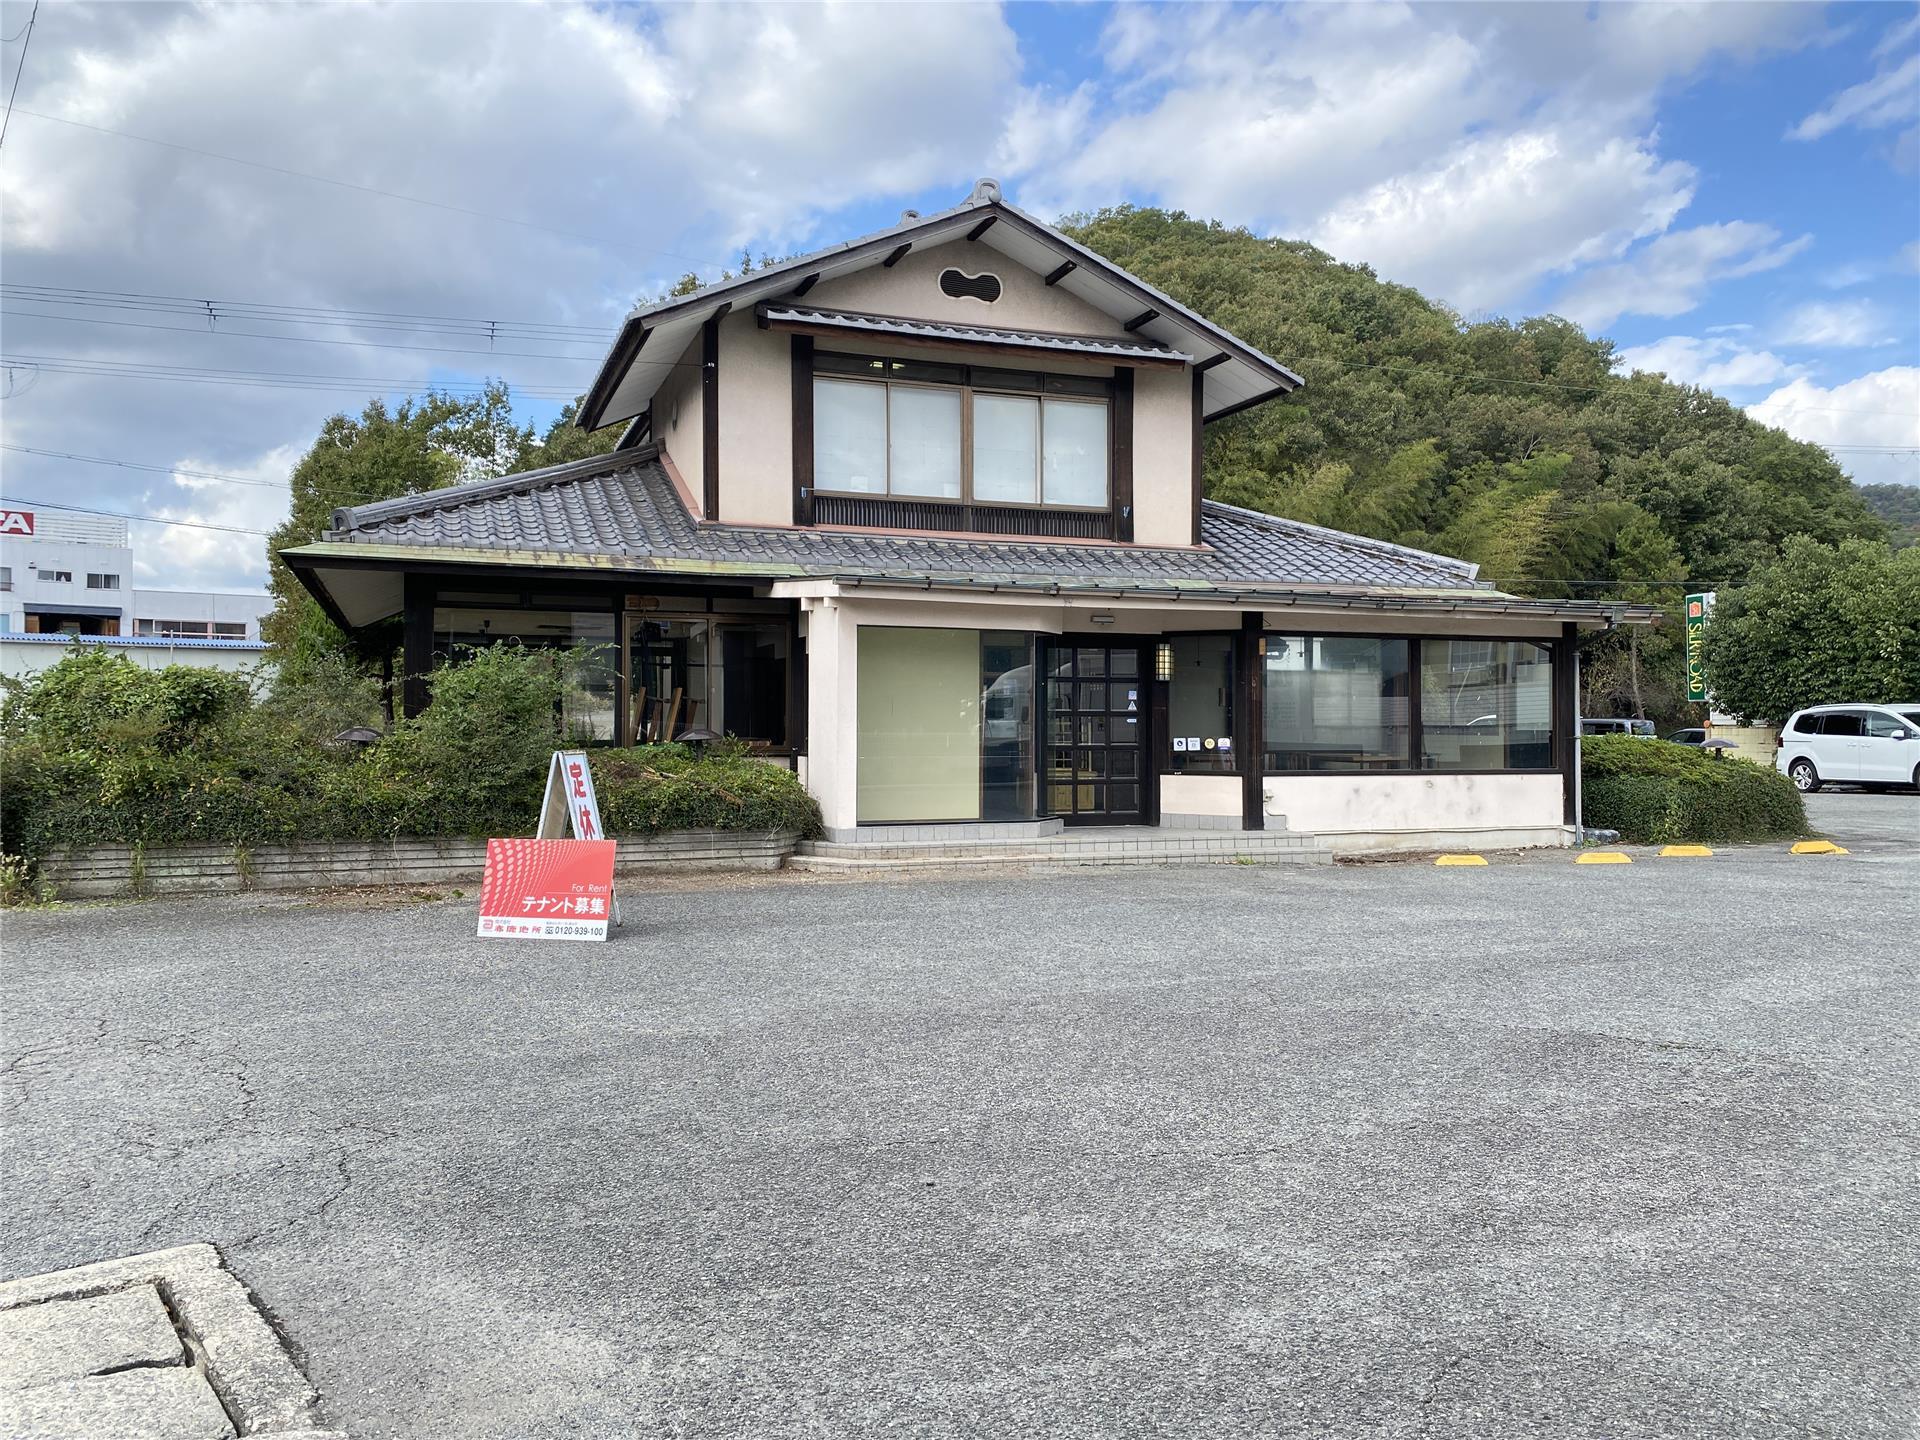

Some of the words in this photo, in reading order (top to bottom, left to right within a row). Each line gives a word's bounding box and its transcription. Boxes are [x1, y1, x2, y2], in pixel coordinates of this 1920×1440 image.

[0, 512, 32, 533] A
[569, 762, 596, 840] 定休
[572, 883, 584, 892] For
[588, 884, 608, 893] Rent
[522, 896, 605, 915] テナント募集
[554, 926, 604, 936] 0120-939-100
